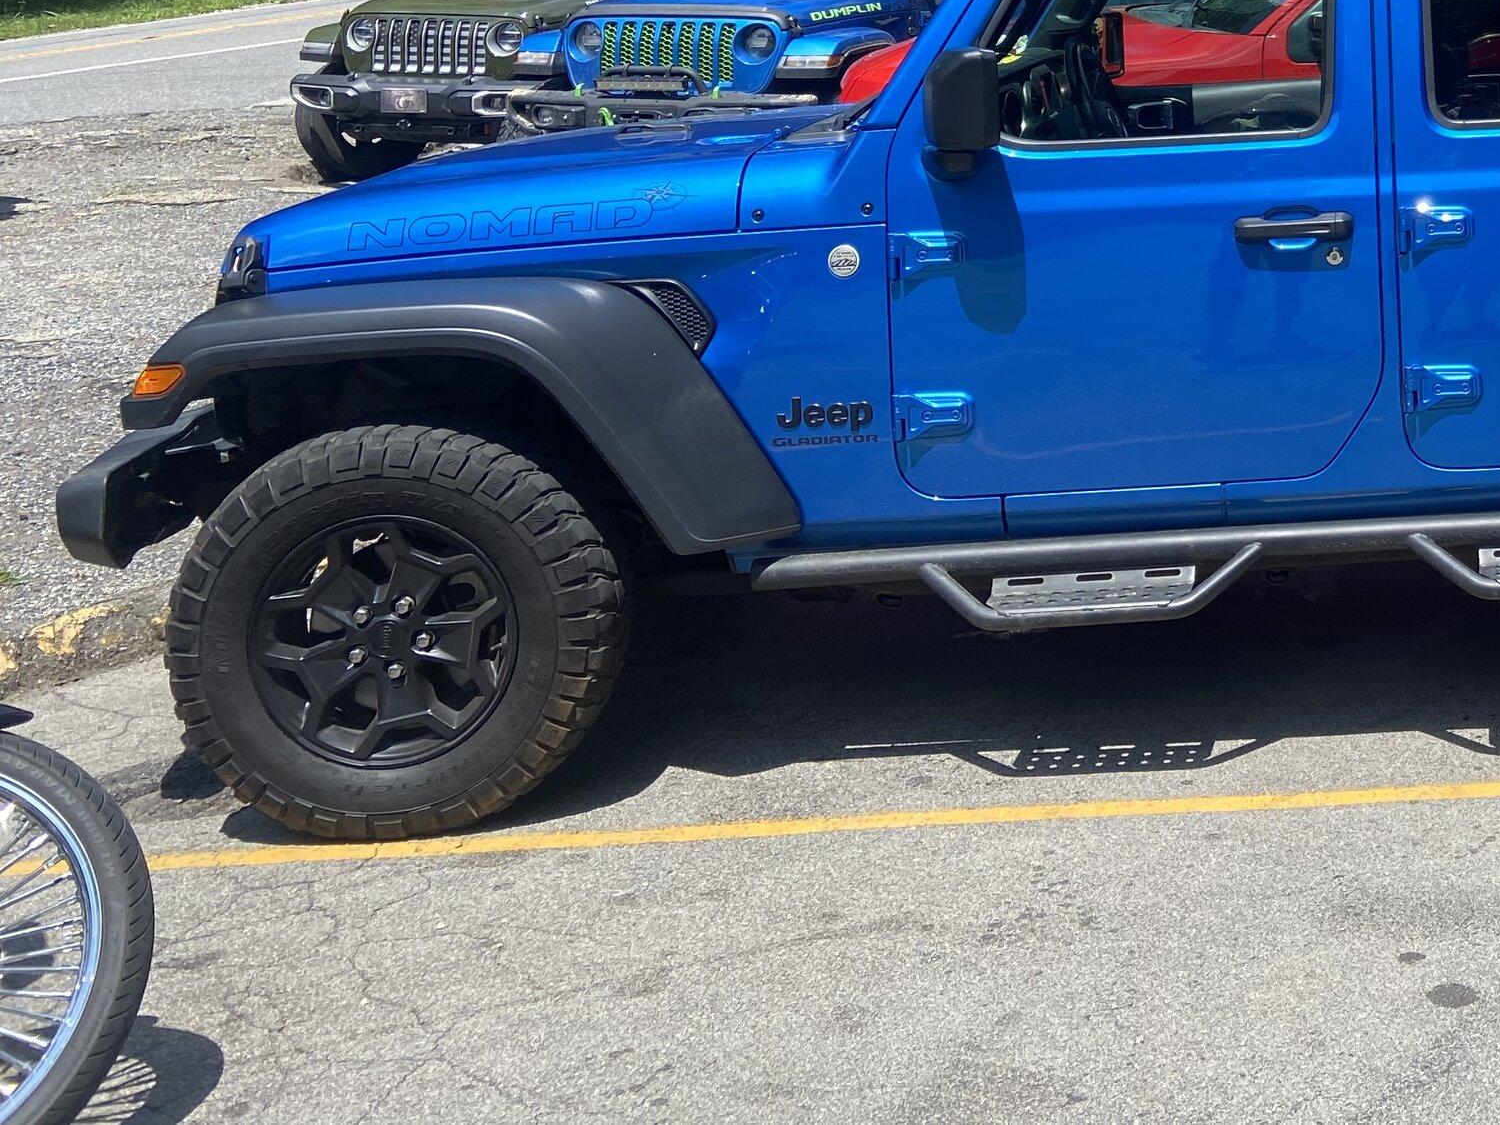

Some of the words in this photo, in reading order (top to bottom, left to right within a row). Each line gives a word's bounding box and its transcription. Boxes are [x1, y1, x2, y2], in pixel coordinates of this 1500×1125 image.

[809, 2, 882, 22] DUMPLIN
[346, 197, 654, 252] NOMAD
[776, 396, 873, 431] Jeep
[771, 434, 880, 447] GLADIATOR
